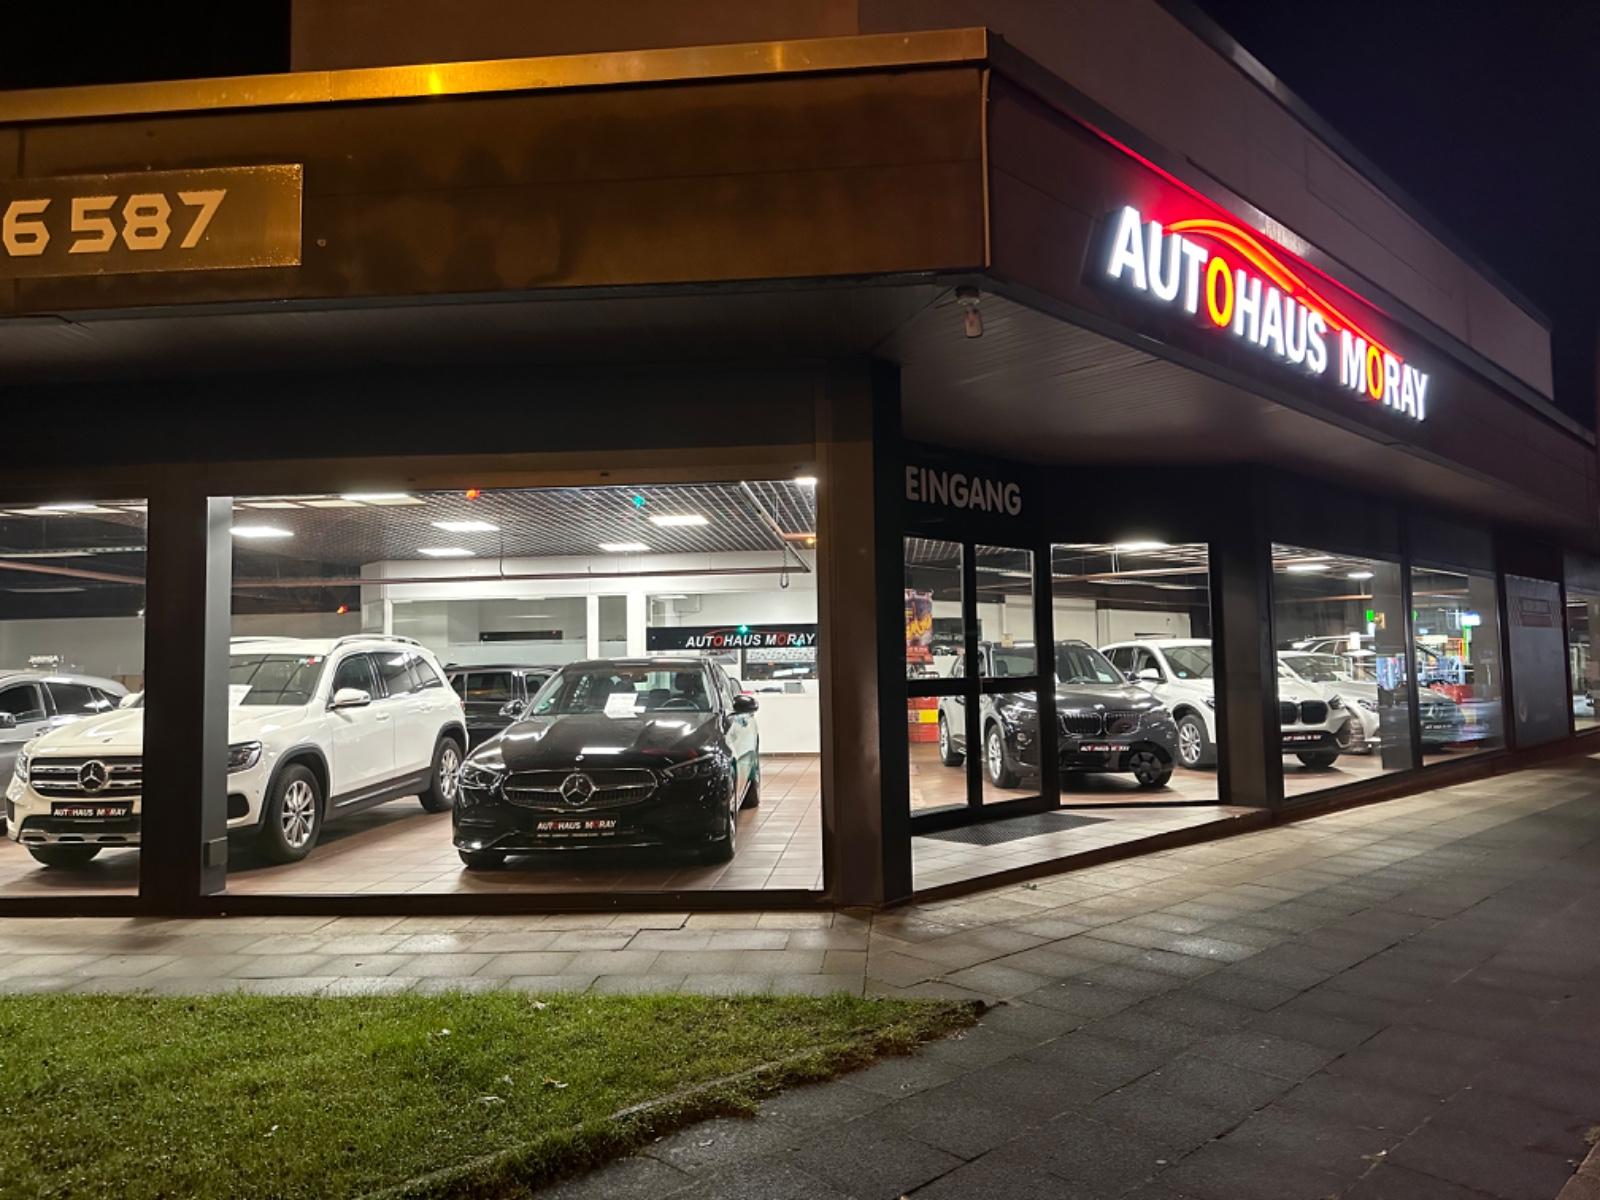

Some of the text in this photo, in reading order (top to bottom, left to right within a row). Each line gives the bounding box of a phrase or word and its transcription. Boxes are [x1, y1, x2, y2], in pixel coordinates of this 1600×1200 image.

[2, 188, 228, 257] 6 587
[1106, 204, 1429, 422] AUTOHAUS MORAY
[905, 465, 1022, 516] EINGANG
[685, 633, 815, 648] AUTOHAUS MORAY
